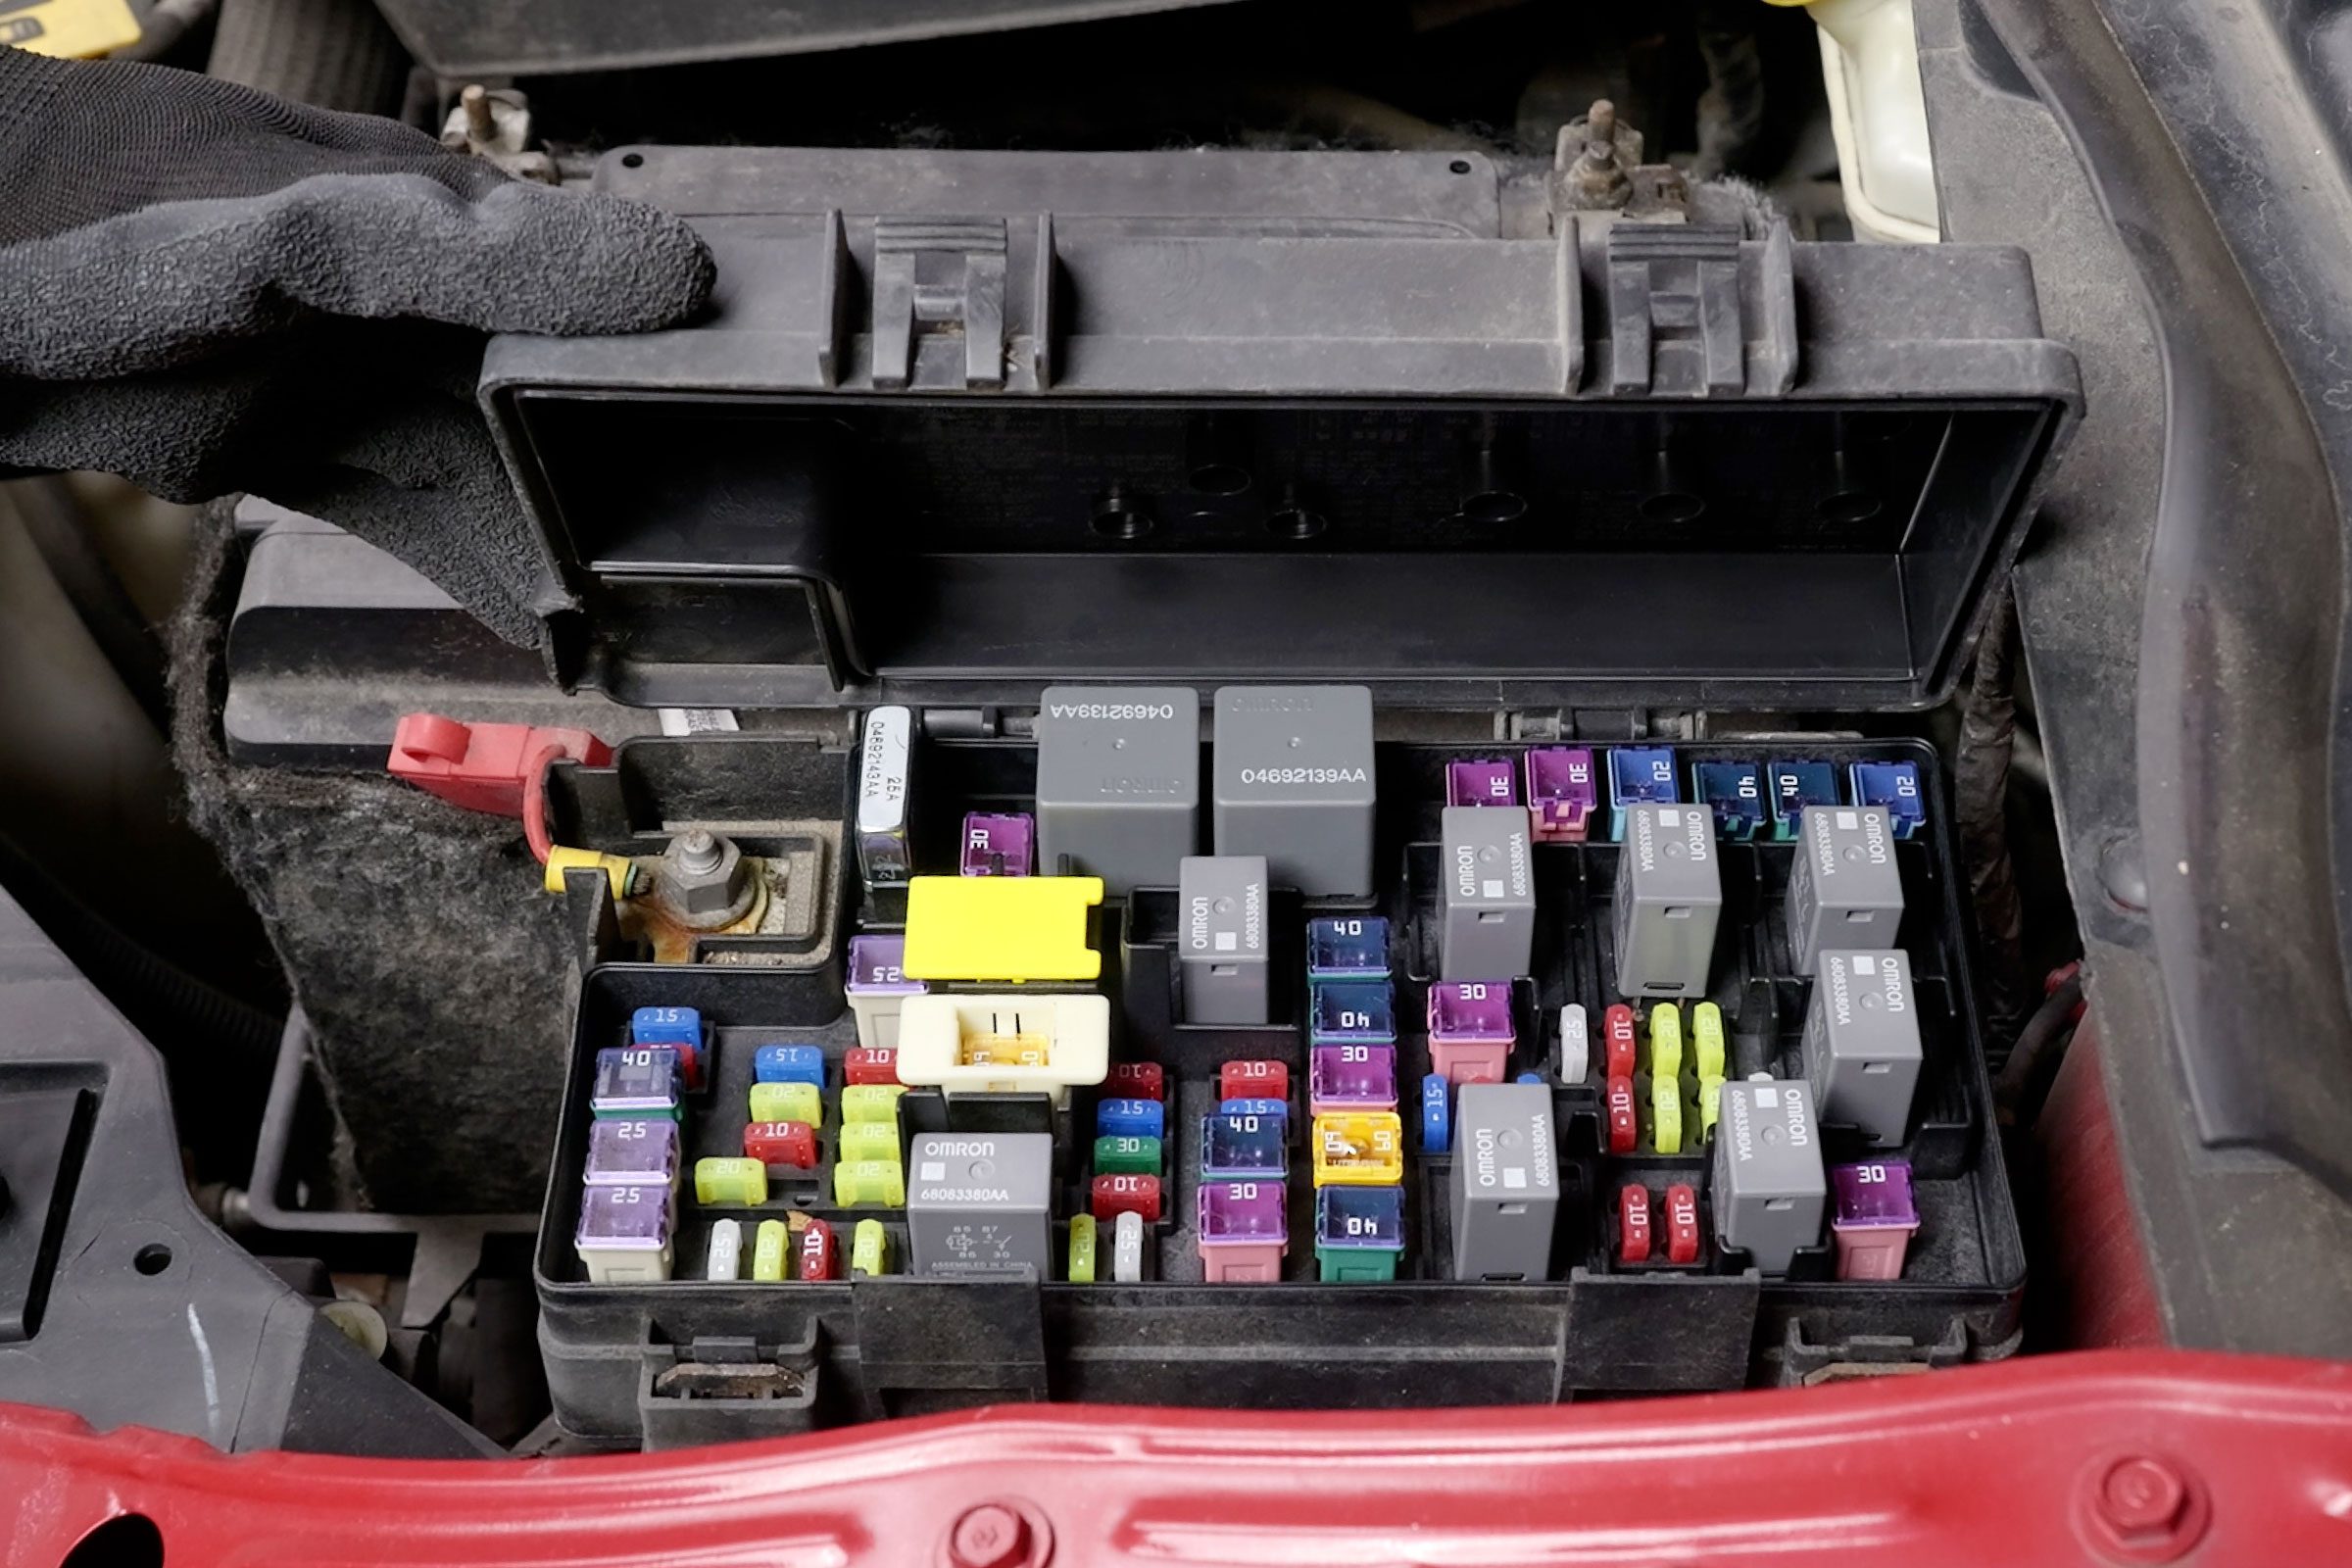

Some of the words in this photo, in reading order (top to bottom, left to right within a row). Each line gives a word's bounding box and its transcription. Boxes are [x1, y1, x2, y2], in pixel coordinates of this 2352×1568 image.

[1051, 704, 1173, 719] 04692139AA
[1241, 768, 1367, 784] 04692139AA
[1569, 762, 1588, 783] 30
[1651, 760, 1672, 781] 20
[1491, 776, 1509, 797] 30
[1738, 775, 1757, 799] 40
[1779, 774, 1799, 797] 40
[1895, 776, 1917, 798] 20
[970, 828, 989, 850] 30
[1334, 920, 1362, 936] 40
[872, 966, 900, 982] 25
[1459, 983, 1487, 1001] 30
[655, 1008, 678, 1022] 15
[1341, 1010, 1370, 1028] 40
[1567, 1020, 1583, 1039] 25
[1613, 1020, 1632, 1040] 10
[622, 1051, 651, 1066] 40
[775, 1048, 799, 1061] 15
[865, 1049, 890, 1063] 10
[1341, 1046, 1368, 1062] 30
[1119, 1064, 1142, 1078] 10
[1244, 1062, 1266, 1077] 10
[1427, 1089, 1444, 1107] 15
[1611, 1093, 1631, 1113] 10
[1120, 1101, 1144, 1114] 15
[1245, 1101, 1268, 1114] 15
[617, 1122, 647, 1138] 25
[764, 1123, 790, 1137] 10
[1229, 1116, 1259, 1133] 40
[925, 1142, 995, 1157] OMRON
[1116, 1139, 1140, 1152] 30
[716, 1160, 740, 1174] 20
[1856, 1165, 1886, 1184] 30
[1114, 1177, 1138, 1192] 10
[1229, 1183, 1257, 1200] 30
[611, 1188, 641, 1203] 25
[920, 1189, 1009, 1201] 68083380AA
[1628, 1203, 1647, 1226] 10
[1675, 1202, 1694, 1225] 10
[1347, 1217, 1377, 1235] 40
[804, 1235, 823, 1255] 10
[1120, 1230, 1137, 1250] 25
